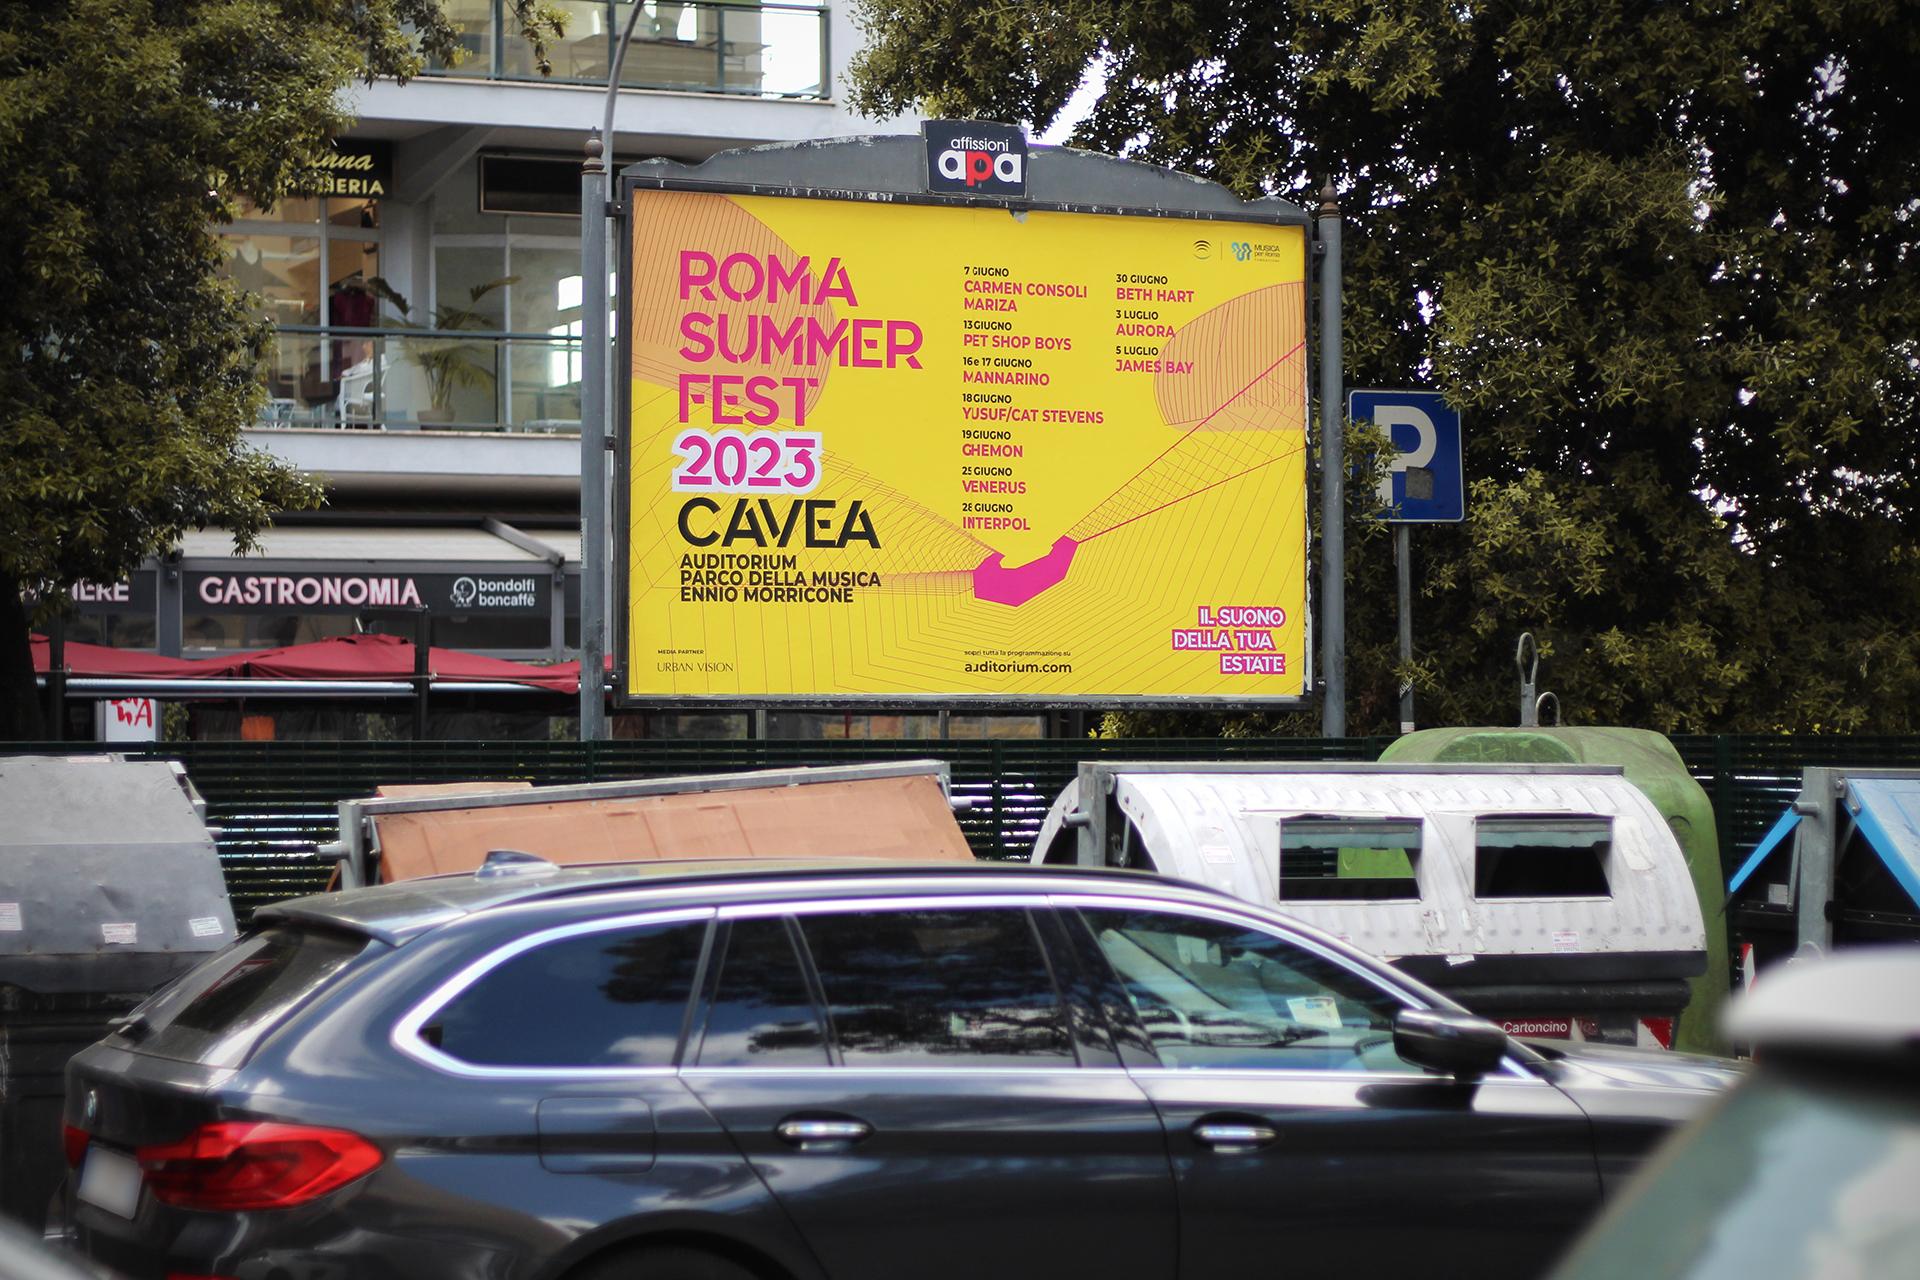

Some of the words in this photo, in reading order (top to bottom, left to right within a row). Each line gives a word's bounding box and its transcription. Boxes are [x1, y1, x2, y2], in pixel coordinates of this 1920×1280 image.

[951, 136, 1009, 151] affissioni
[938, 150, 1021, 186] apa
[679, 250, 858, 306] ROMA
[964, 266, 970, 275] 7
[972, 267, 1009, 277] GIUGNO
[1116, 274, 1128, 283] 30
[1130, 274, 1168, 285] GIUGNO
[964, 280, 1022, 295] CARMEN
[1026, 283, 1087, 298] CONSOLI
[1116, 287, 1152, 301] BETH
[1157, 289, 1194, 302] HART
[964, 297, 1018, 312] MARIZA
[1116, 310, 1121, 319] 3
[1124, 310, 1159, 320] LUGLIO
[963, 320, 973, 329] 13
[973, 320, 1012, 331] GIUGNO
[1116, 323, 1176, 337] AURORA
[679, 312, 923, 369] SUMMER
[963, 334, 988, 347] PET
[992, 335, 1031, 349] SHOP
[1035, 337, 1072, 351] BOYS
[1115, 346, 1121, 354] 5
[1124, 346, 1159, 356] LUGLIO
[962, 357, 973, 366] 16
[982, 357, 991, 367] 17
[993, 358, 1033, 368] GIUGNO
[1115, 359, 1161, 373] JAMES
[1166, 361, 1194, 374] BAY
[963, 370, 1050, 386] MANNARINO
[679, 374, 819, 426] FEST
[962, 393, 973, 403] 18
[973, 394, 1012, 404] GIUGNO
[962, 406, 1039, 422] YUSUF/CAT
[1042, 409, 1104, 424] STEVENS
[962, 430, 972, 439] 19
[972, 430, 1011, 440] GIUGNO
[962, 443, 1023, 458] GHEMON
[1374, 405, 1437, 507] P
[679, 435, 816, 487] 2023
[974, 466, 1013, 477] GIUGNO
[962, 480, 1026, 494] VENERUS
[974, 503, 1013, 513] GIUGNO
[677, 497, 882, 549] CAVEA
[962, 516, 1031, 531] INTERPOL
[680, 554, 797, 570] AUDITORIUM
[478, 578, 535, 592] bondolfi
[680, 570, 744, 586] PARCO
[749, 571, 807, 586] DELLA
[812, 571, 882, 587] MUSICA
[199, 576, 422, 605] GASTRONOMIA
[680, 587, 738, 602] ENNIO
[743, 587, 854, 603] MORRICONE
[1200, 608, 1215, 625] IL
[1219, 608, 1284, 625] SUONO
[1174, 632, 1231, 648] DELLA
[1236, 632, 1273, 648] TUA
[657, 662, 694, 672] URBAN
[697, 662, 734, 672] VISION
[1222, 656, 1284, 672] ESTATE
[1503, 1021, 1568, 1034] Cartoncino
